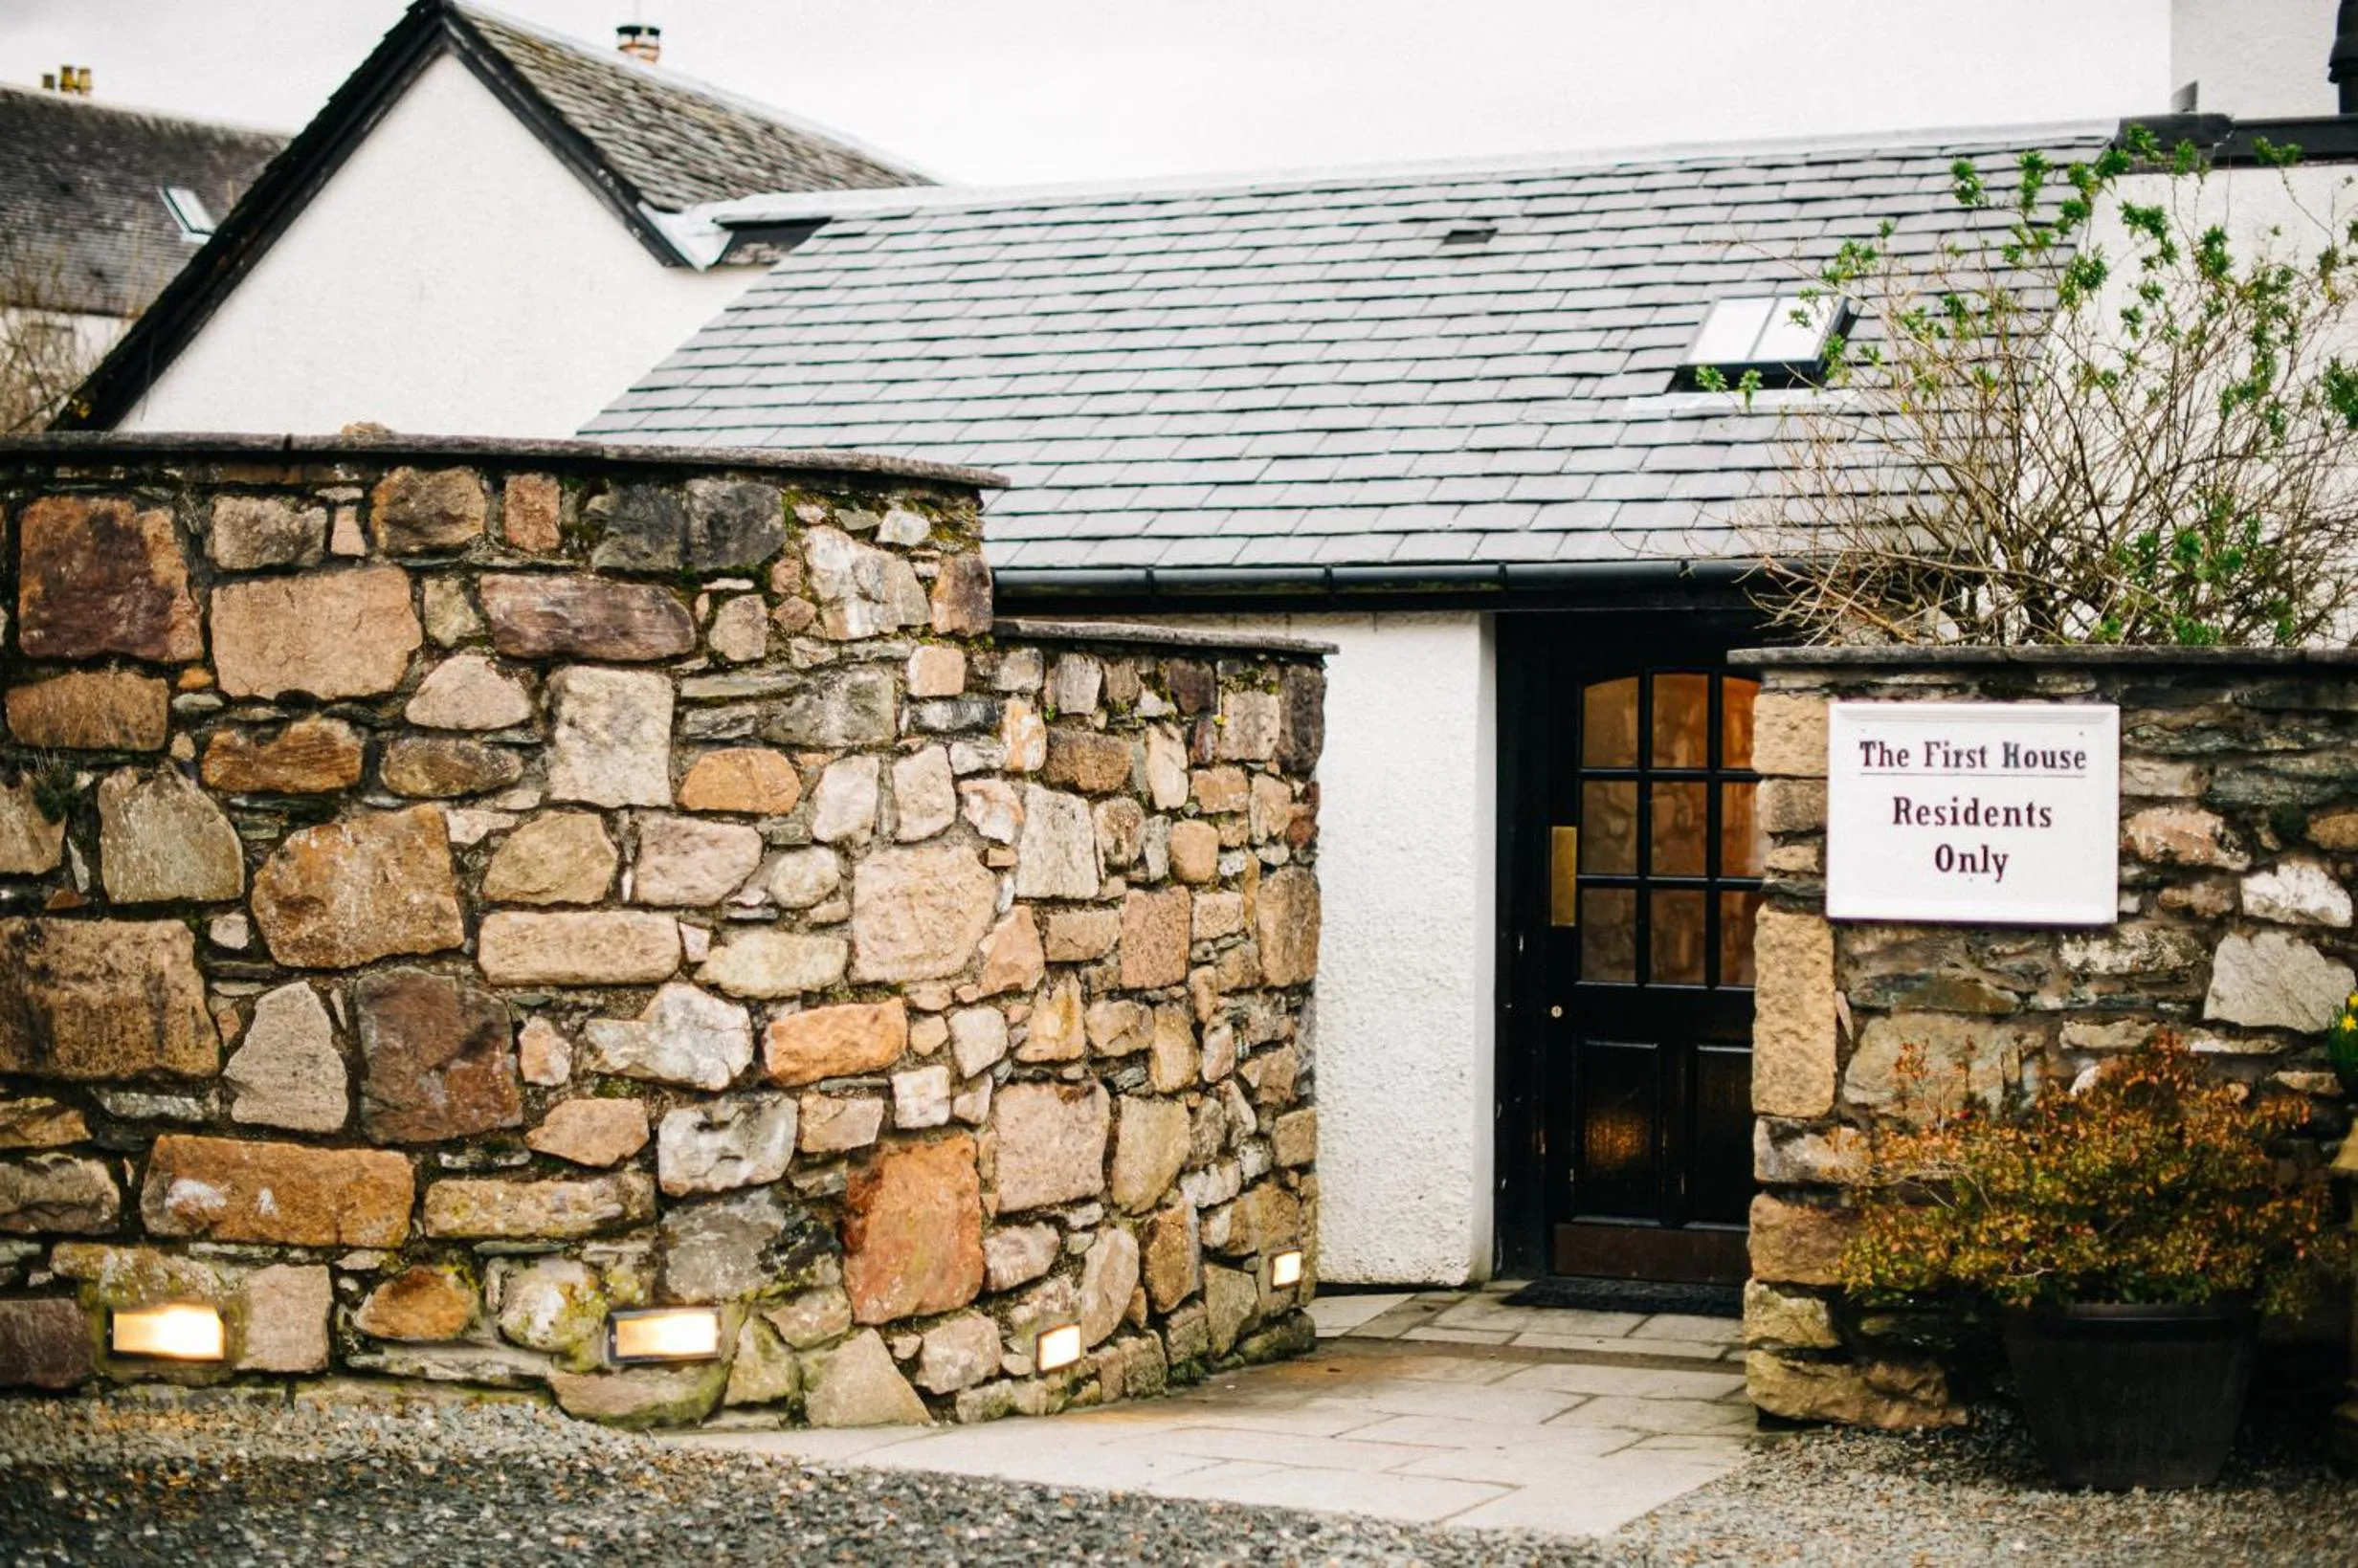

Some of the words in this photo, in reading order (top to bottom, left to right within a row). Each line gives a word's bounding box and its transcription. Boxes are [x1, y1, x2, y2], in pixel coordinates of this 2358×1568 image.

[1858, 740, 1910, 768] The
[1924, 740, 1988, 769] First
[2002, 741, 2087, 770] House
[1893, 796, 2053, 828] Residents
[1934, 843, 2010, 883] Only
